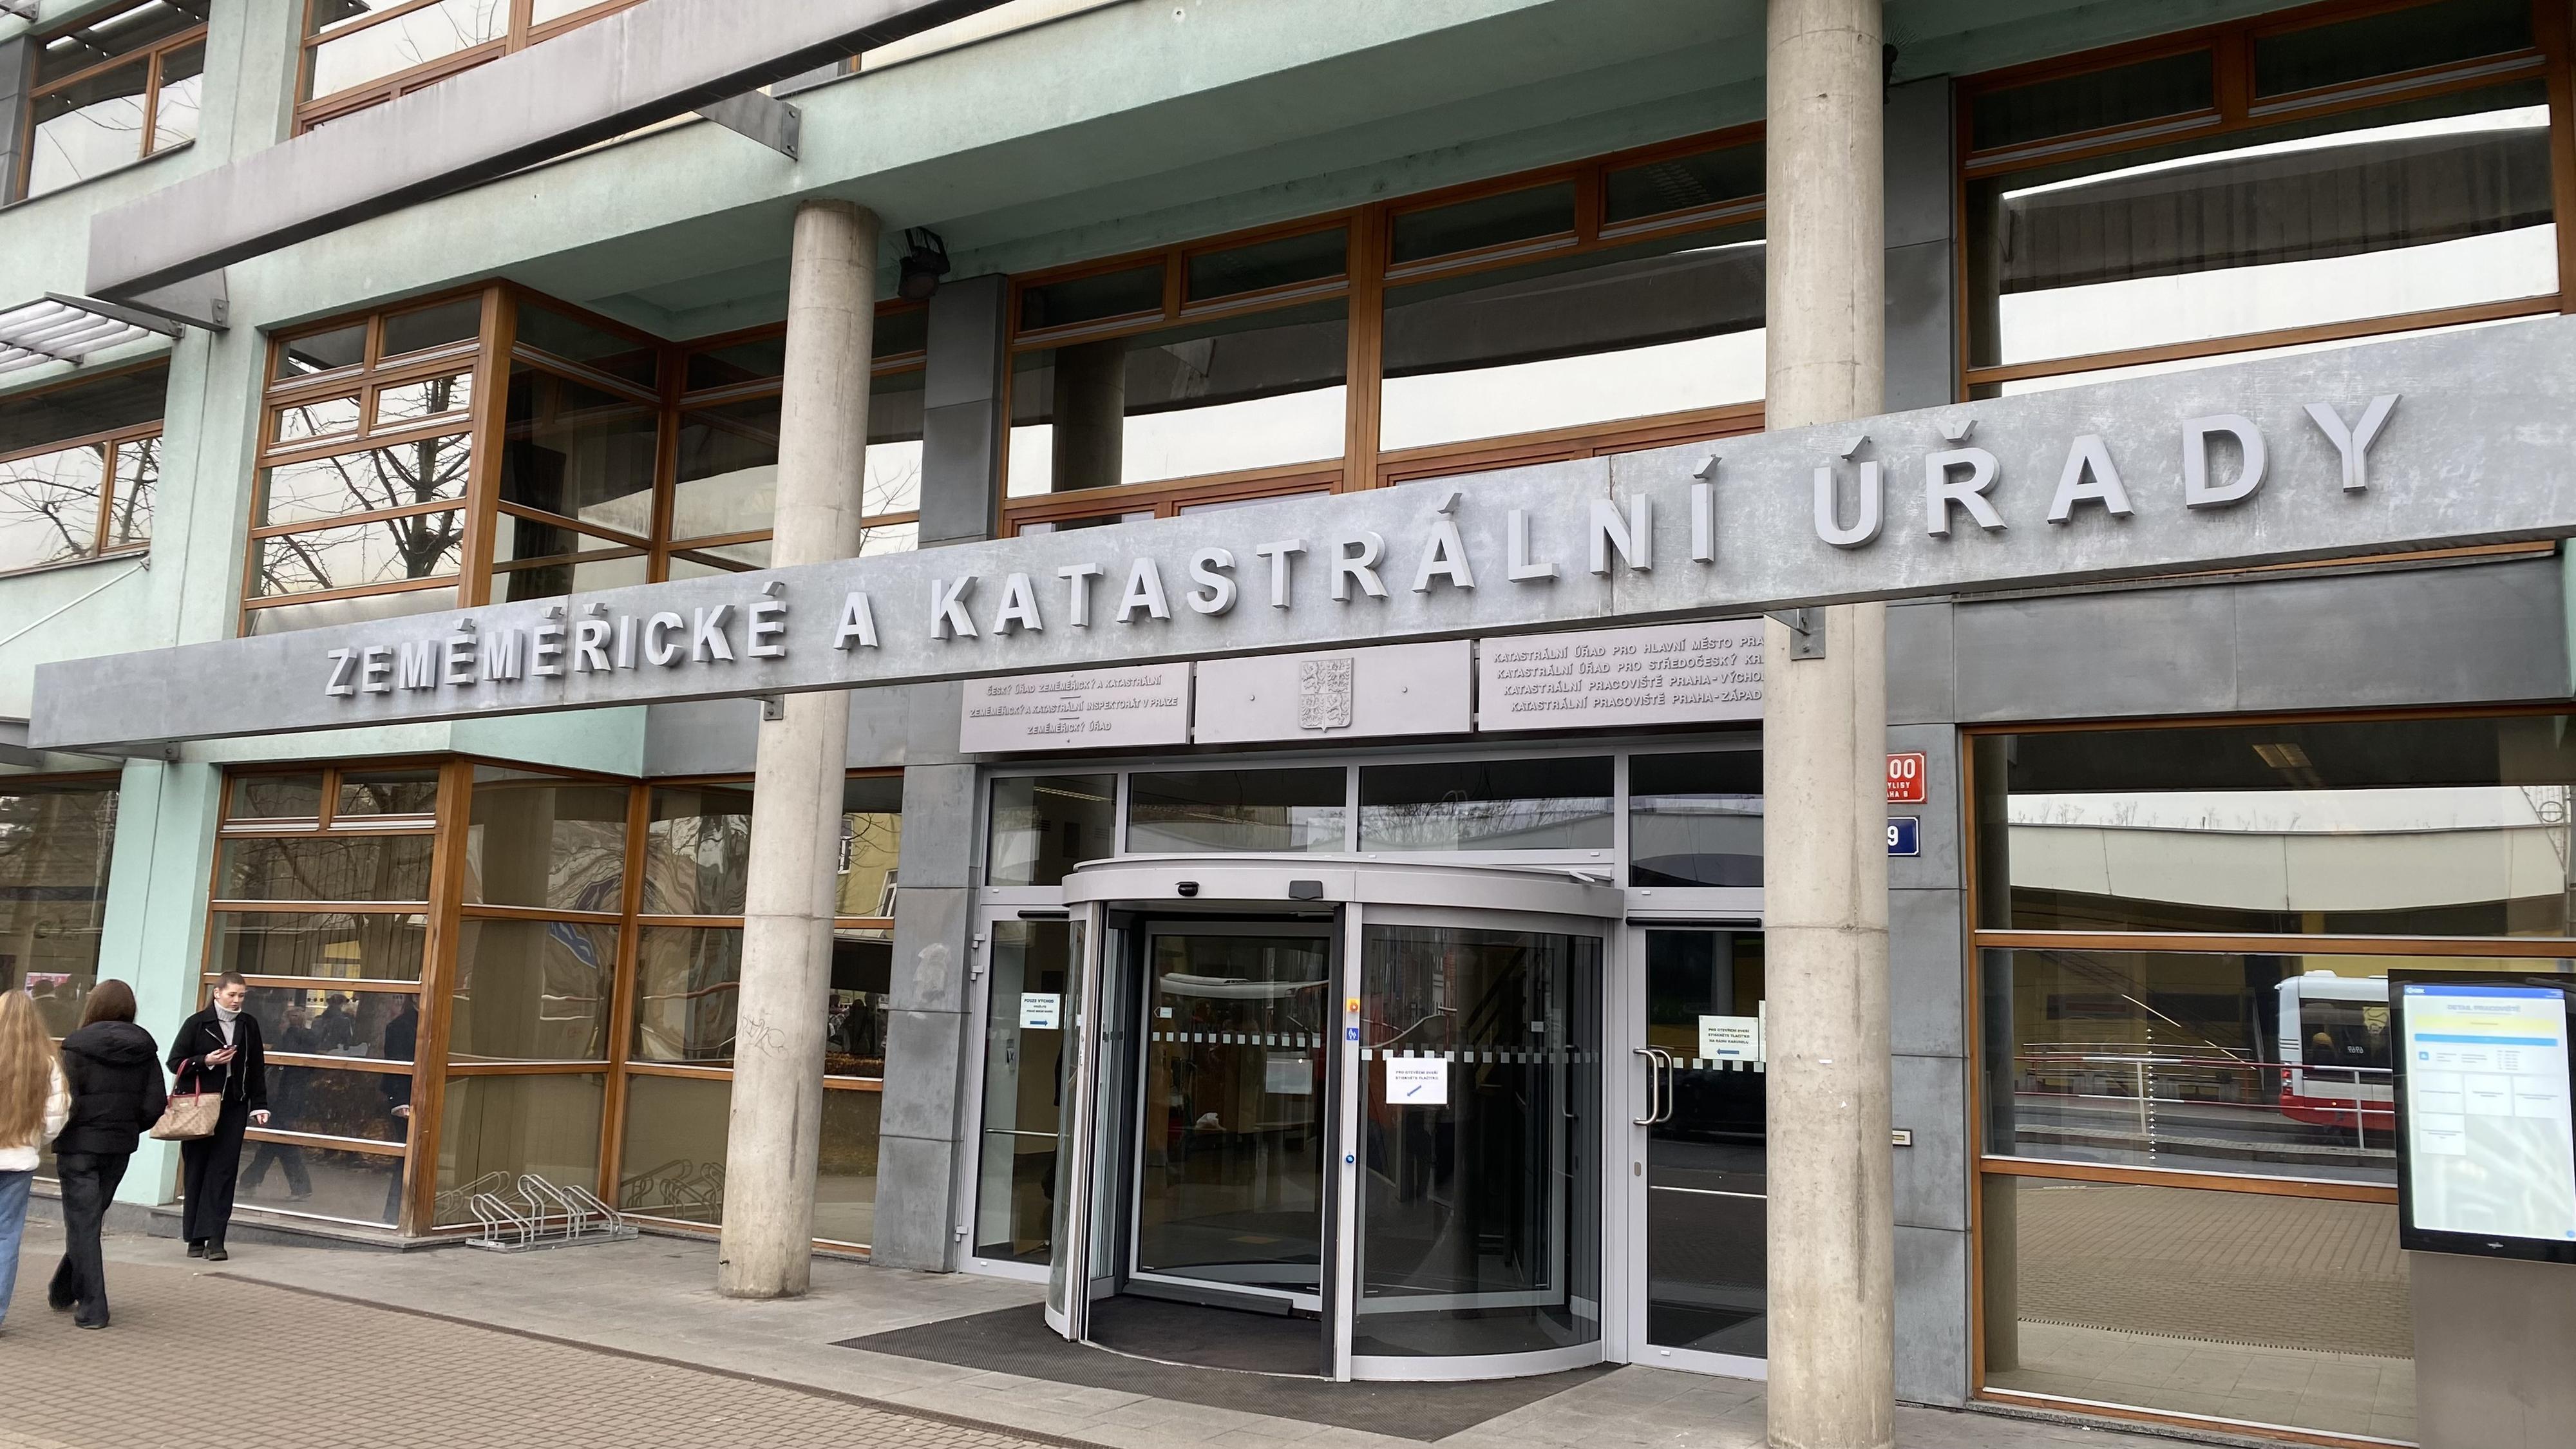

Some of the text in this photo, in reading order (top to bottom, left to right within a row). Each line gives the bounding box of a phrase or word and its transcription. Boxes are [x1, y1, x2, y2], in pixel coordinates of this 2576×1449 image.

[325, 393, 2403, 697] ZEMĚMĚŘICKÉ A KATASTRÁLNÍ ÚŘADY
[1494, 646, 1569, 663] KATASTRÁLNÍ
[1575, 645, 1606, 658] ÚŘAD
[1613, 645, 1636, 656] PRO
[1643, 639, 1686, 654] HLAVNÍ
[1691, 637, 1732, 650] MĚSTO
[1497, 653, 1765, 679] KATASTRÁLNÍ ÚŘAD PRO STŘEDOČESKÝ KR
[987, 685, 1012, 696] ČESKÝ
[1015, 683, 1036, 694] ÚŘAD
[1097, 680, 1103, 688] A
[1105, 675, 1162, 688] KATASTRÁLNÍ
[1504, 670, 1765, 696] KATASTRÁLNÍ PRACOVIŠTĚ PRAHA-VÝCHO
[1032, 701, 1084, 714] KATASTRÁLNÍ
[1086, 698, 1141, 710] INSPEKTORÁT
[1143, 699, 1148, 708] V
[1150, 697, 1178, 707] PRAZE
[1511, 696, 1588, 712] KATASTRÁLNÍ
[1593, 692, 1665, 708] PRACOVIŠTĚ
[1088, 720, 1112, 732] ÚŘAD
[1888, 826, 1899, 846] 9
